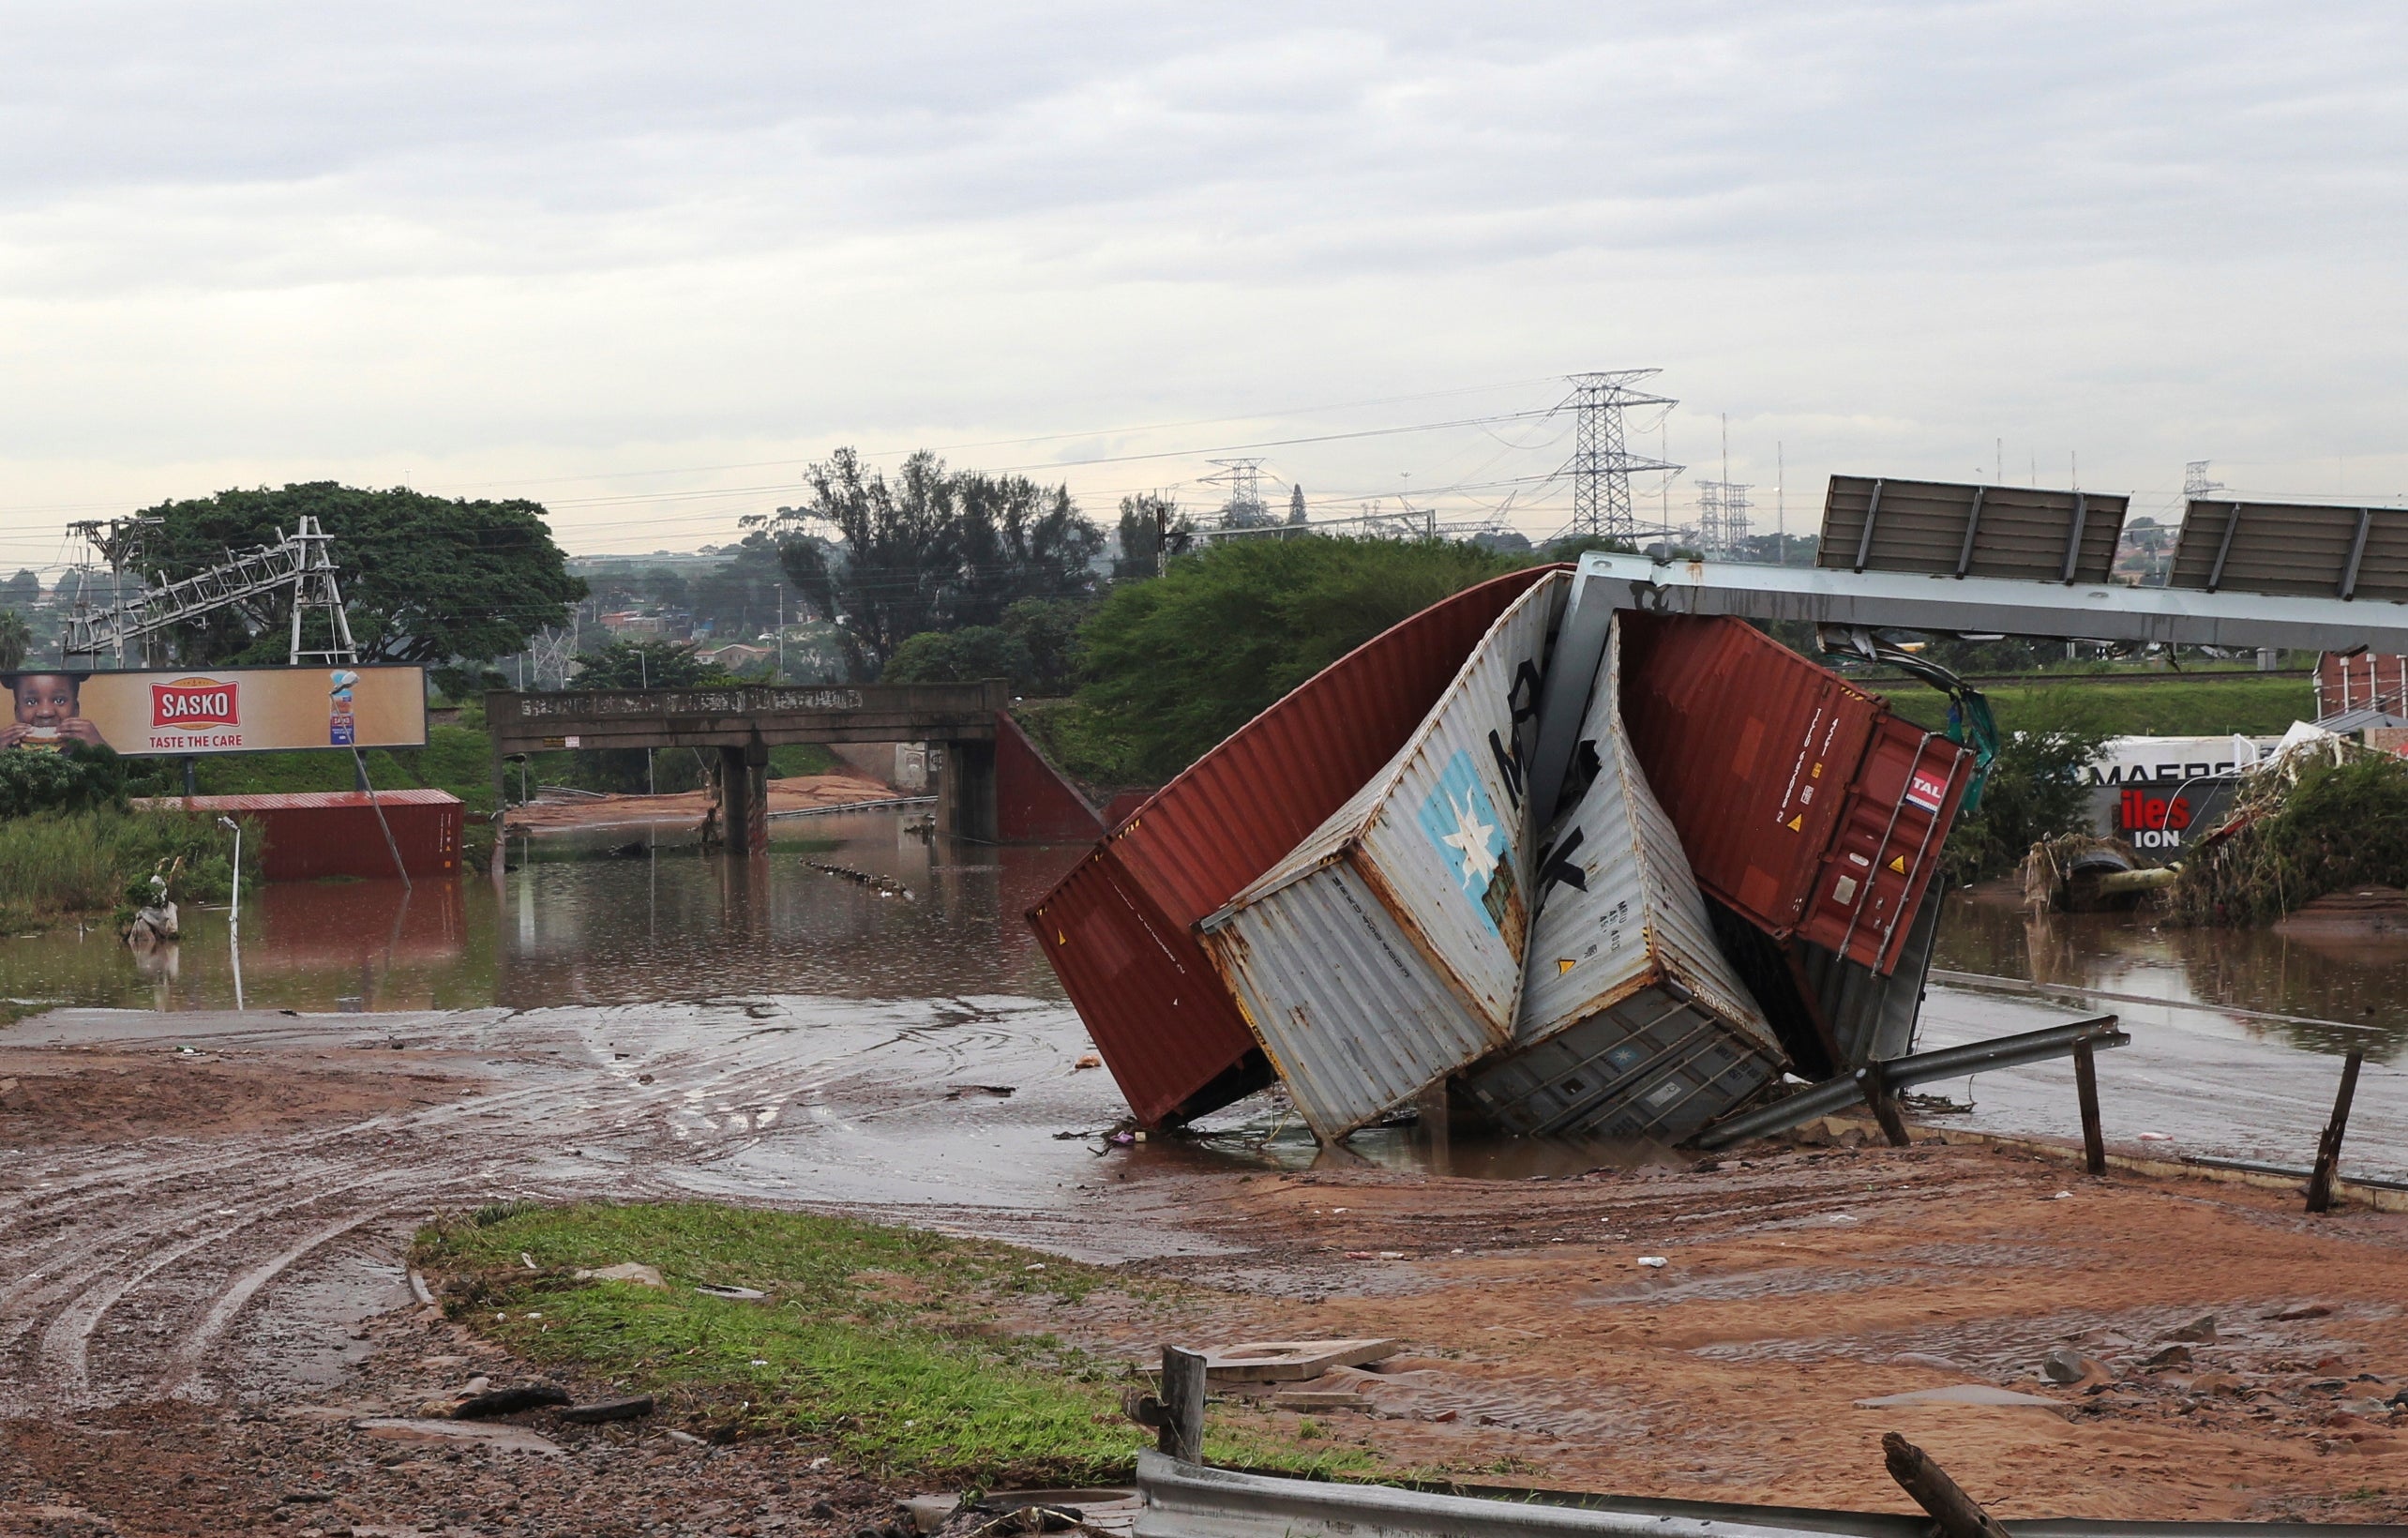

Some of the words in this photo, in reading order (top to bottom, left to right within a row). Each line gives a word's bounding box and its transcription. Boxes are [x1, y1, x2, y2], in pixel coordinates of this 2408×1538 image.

[161, 692, 229, 717] SASKO
[150, 736, 185, 748] TASTE
[188, 735, 209, 746] THE
[212, 734, 242, 746] CARE
[1913, 777, 1942, 799] TAL
[2121, 789, 2191, 830] iles
[2135, 830, 2180, 848] ION
